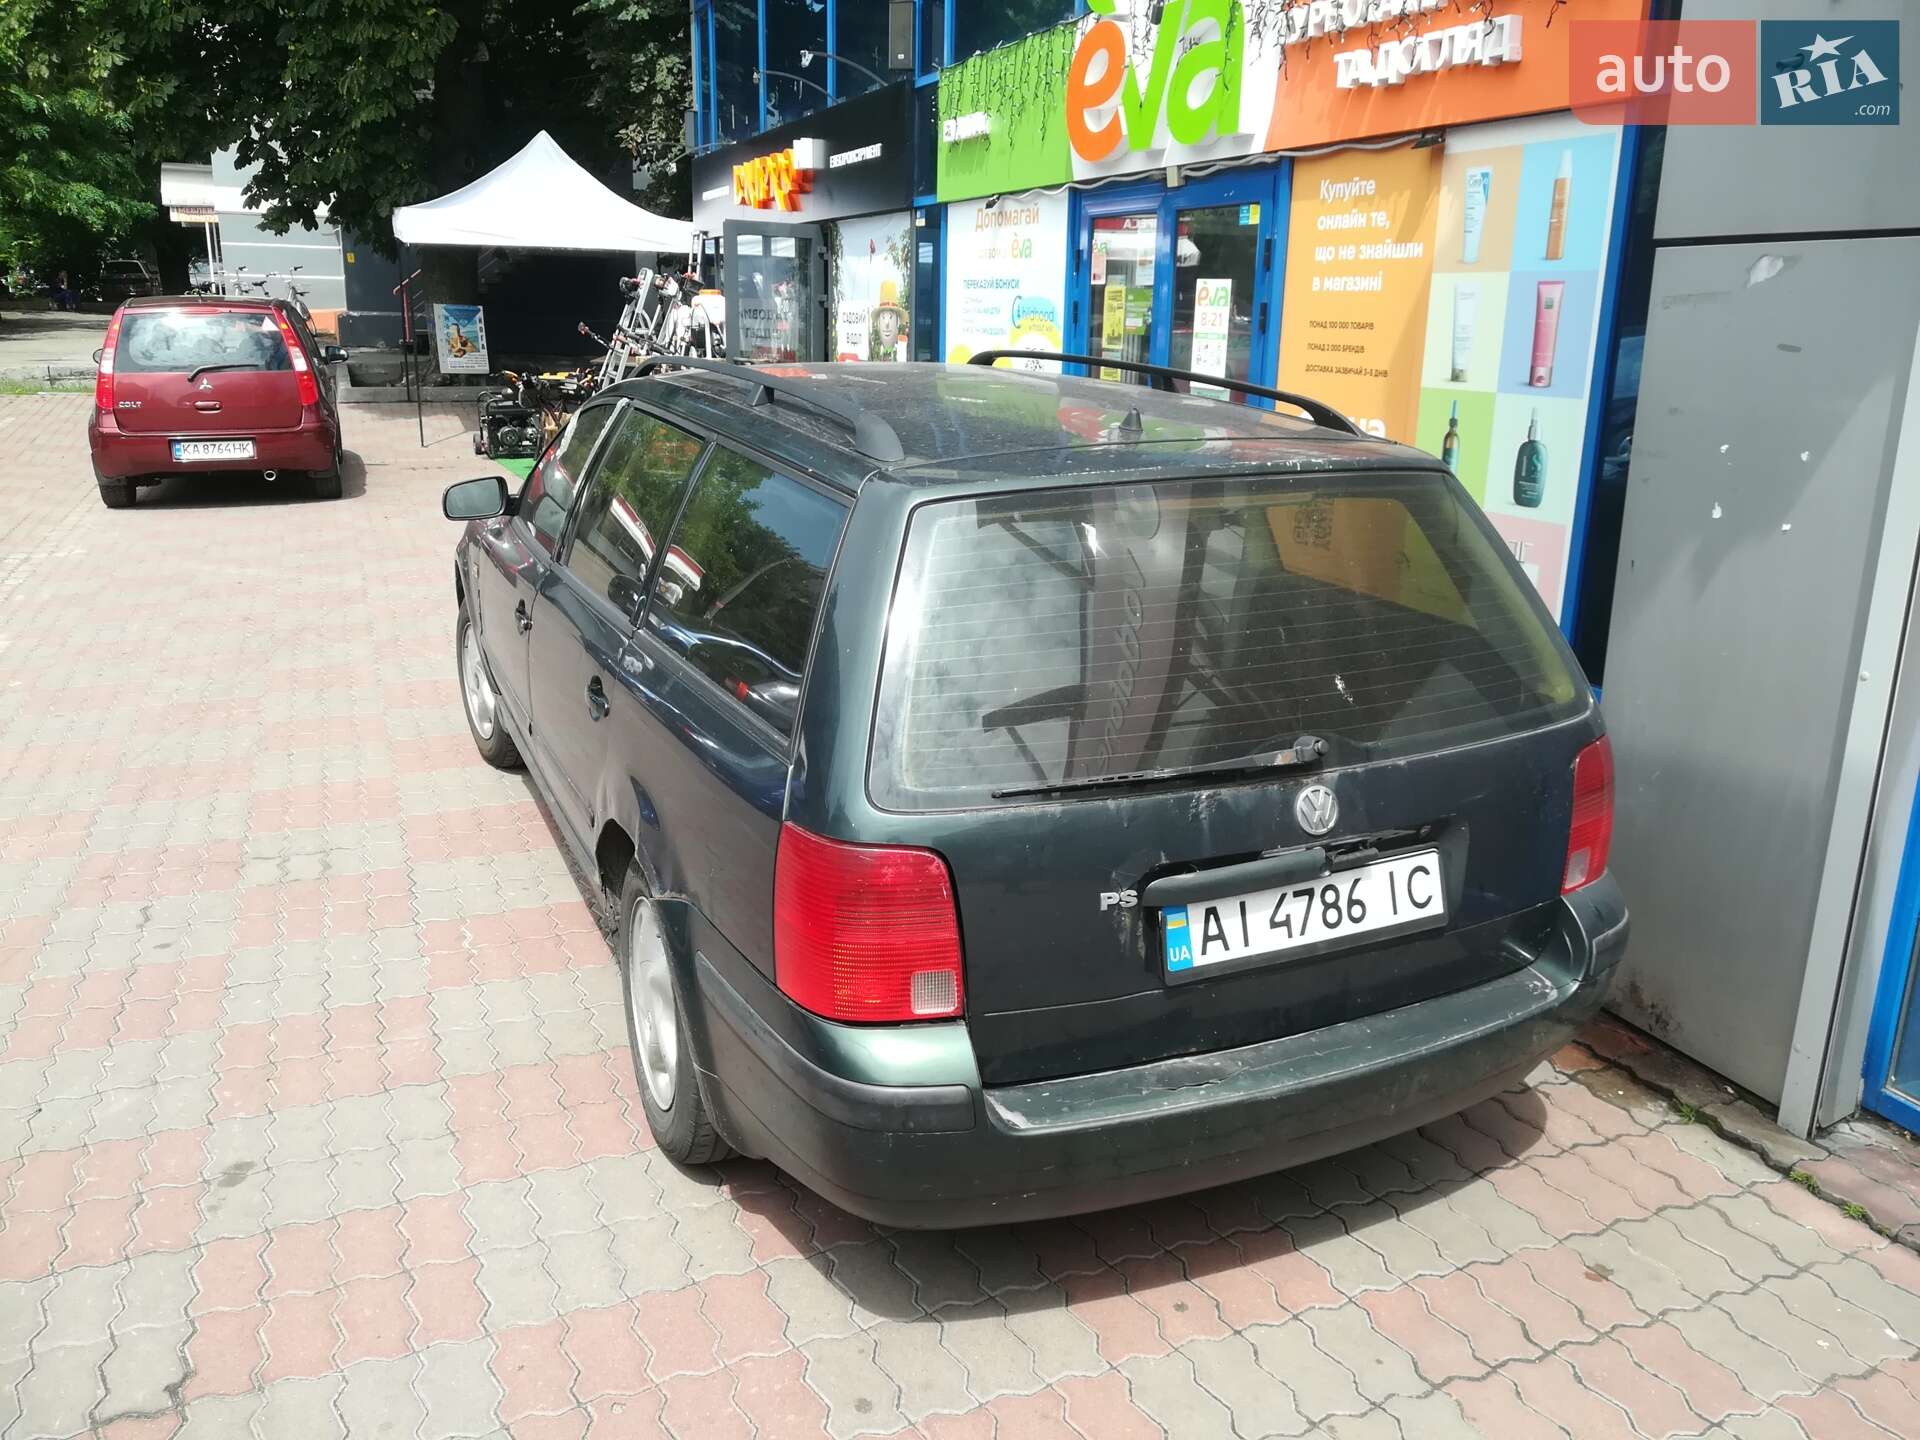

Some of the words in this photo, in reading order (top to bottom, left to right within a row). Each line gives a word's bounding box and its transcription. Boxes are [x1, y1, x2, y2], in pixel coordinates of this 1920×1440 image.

[1320, 177, 1376, 203] Купуйте
[975, 202, 1039, 232] Допомагай
[1317, 209, 1367, 231] онлайн
[1370, 210, 1390, 230] те,
[1315, 245, 1335, 264] що
[1338, 245, 1356, 261] не
[1359, 239, 1423, 260] знайшли
[963, 277, 995, 289] ПЕРЕКАЗУЙ
[995, 279, 1020, 289] БОНУСИ
[1312, 276, 1320, 292] в
[1323, 270, 1383, 292] магазині
[1309, 320, 1328, 329] ПОНАД
[1329, 321, 1338, 329] 100
[1350, 321, 1375, 330] ТОВАРІВ
[1307, 342, 1326, 352] ПОНАД
[1305, 363, 1334, 373] ДОСТАВКА
[1335, 365, 1363, 375] ЗАЗВИЧАЙ
[203, 442, 232, 455] 8764
[1269, 877, 1368, 940] 4786
[1168, 943, 1193, 964] UA
